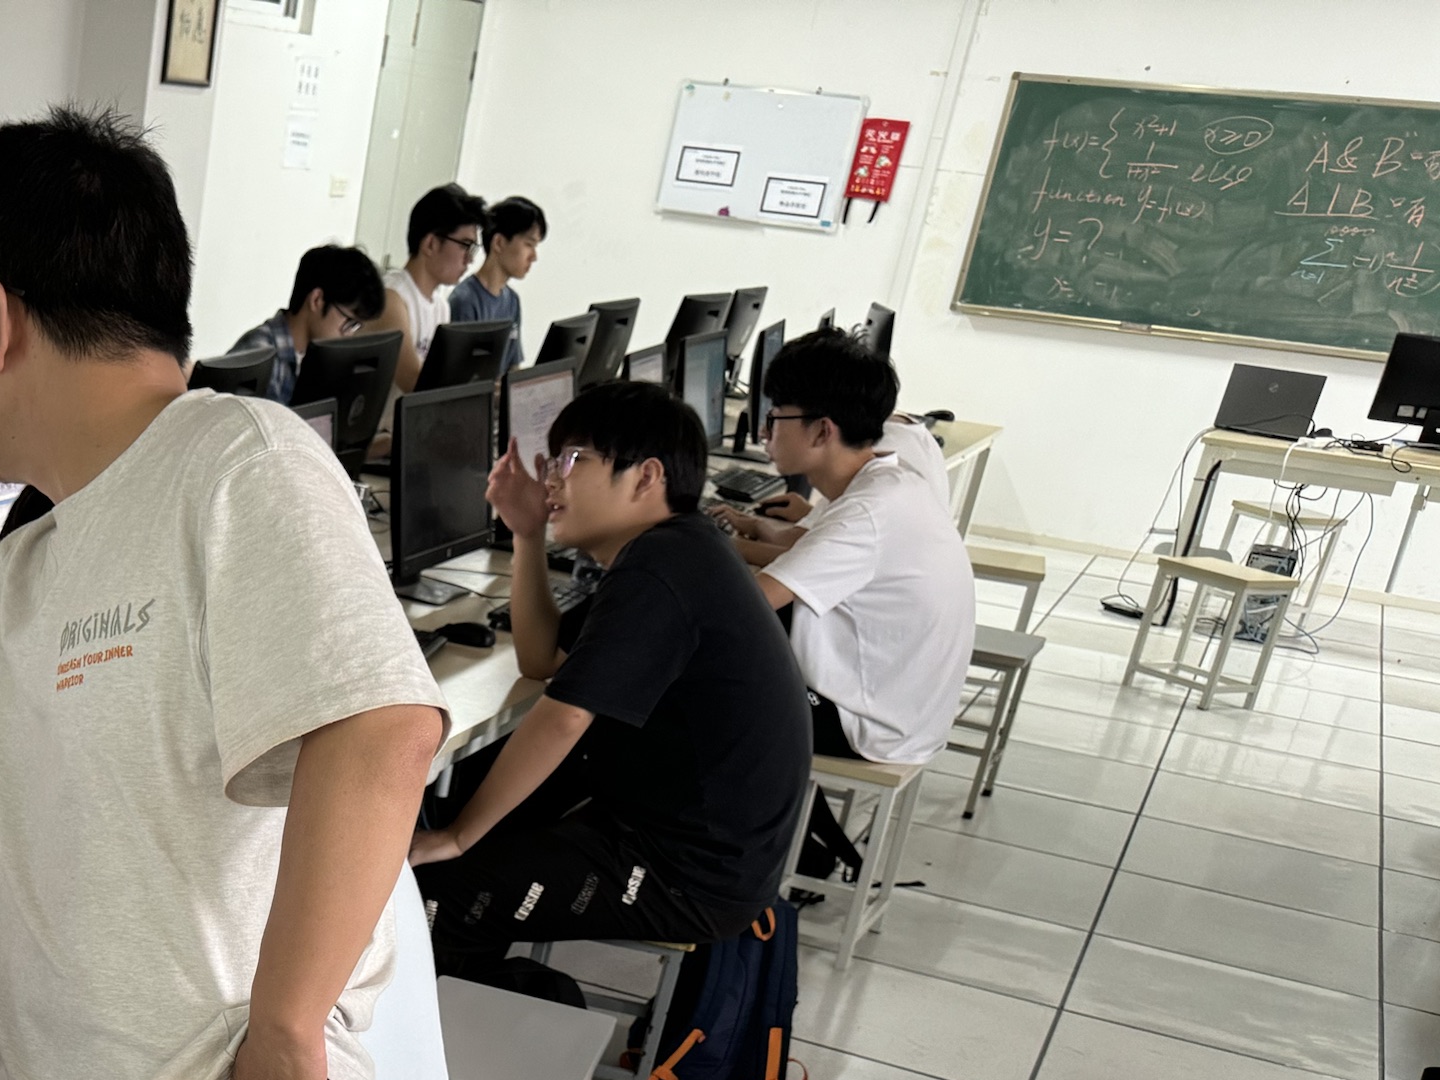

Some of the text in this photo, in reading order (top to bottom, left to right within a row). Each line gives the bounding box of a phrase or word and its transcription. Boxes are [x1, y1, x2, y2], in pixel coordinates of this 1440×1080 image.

[1032, 166, 1127, 214] function
[82, 651, 104, 668] YOUR
[103, 645, 134, 662] INNER
